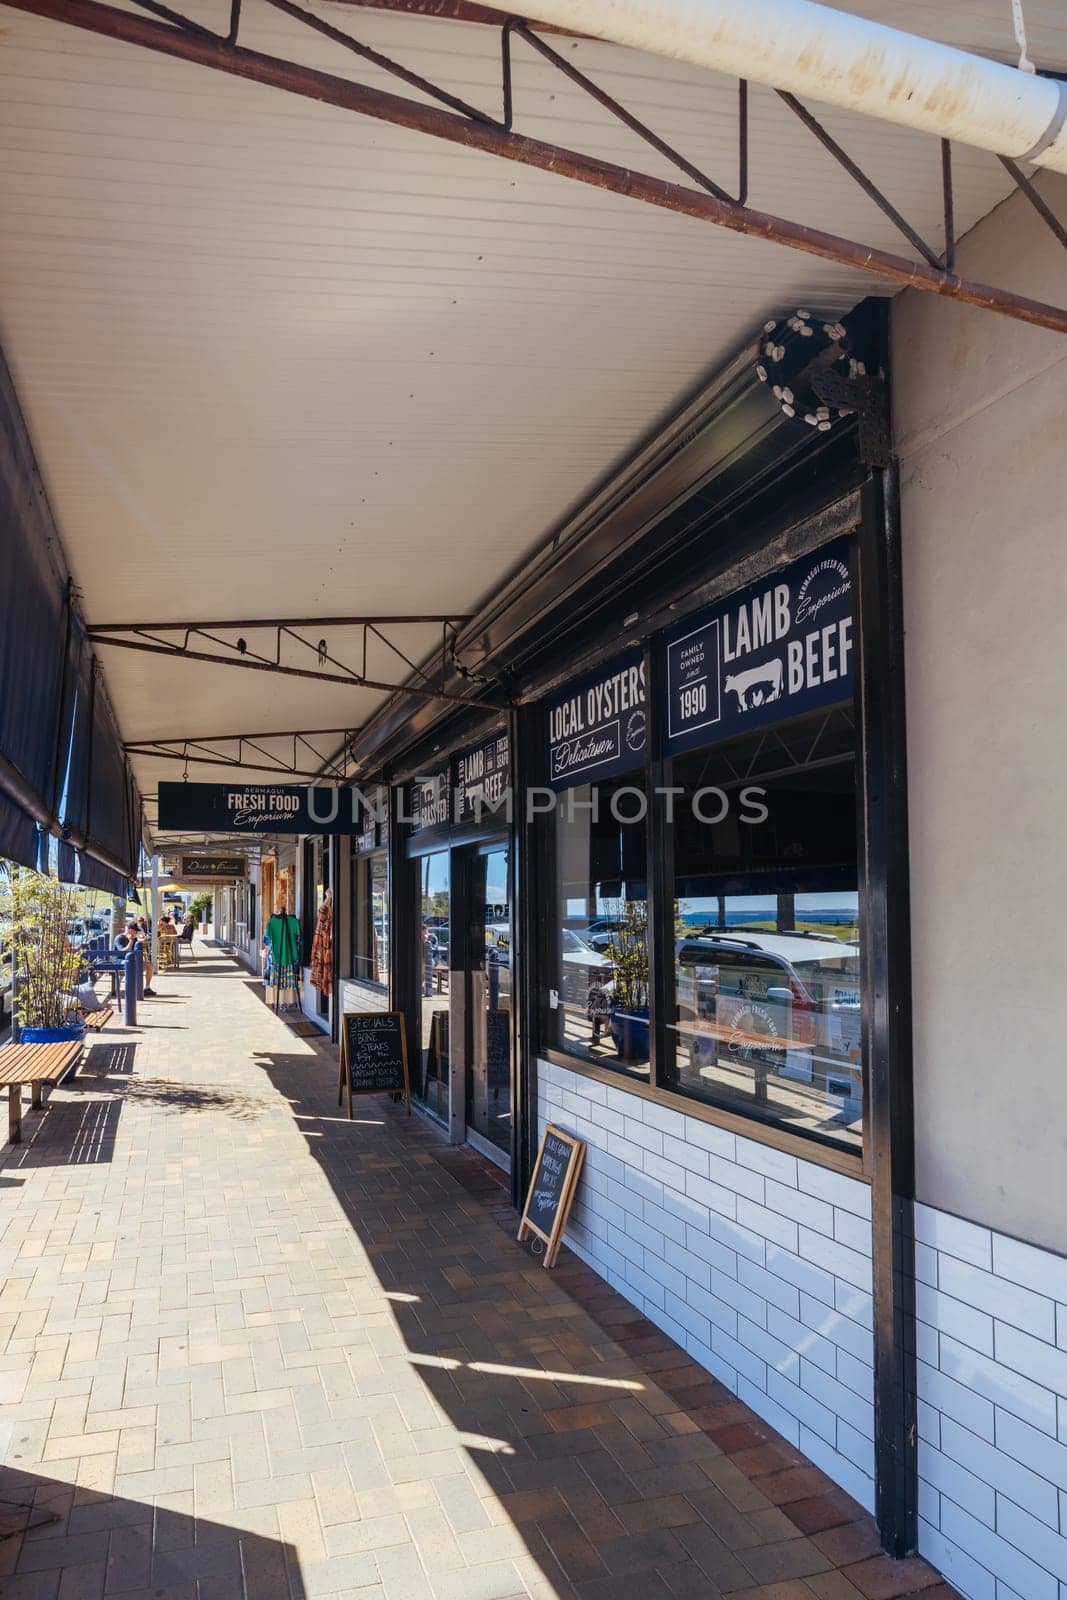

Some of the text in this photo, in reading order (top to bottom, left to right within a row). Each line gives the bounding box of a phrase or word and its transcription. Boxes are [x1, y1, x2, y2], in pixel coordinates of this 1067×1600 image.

[820, 559, 838, 571] FRESH
[836, 561, 849, 579] FOOD
[795, 580, 852, 624] Emporium
[723, 583, 790, 664] LAMB
[680, 652, 705, 670] OWNED
[681, 641, 704, 659] FAMILY
[788, 616, 853, 695] BEEF
[550, 695, 584, 743] LOCAL
[587, 660, 646, 726] OYSTERS
[680, 684, 707, 720] 1990
[464, 750, 484, 783] LAMB
[485, 771, 502, 801] BEEF
[227, 793, 300, 811] FRESH FOOD
[233, 807, 295, 830] Emporium
